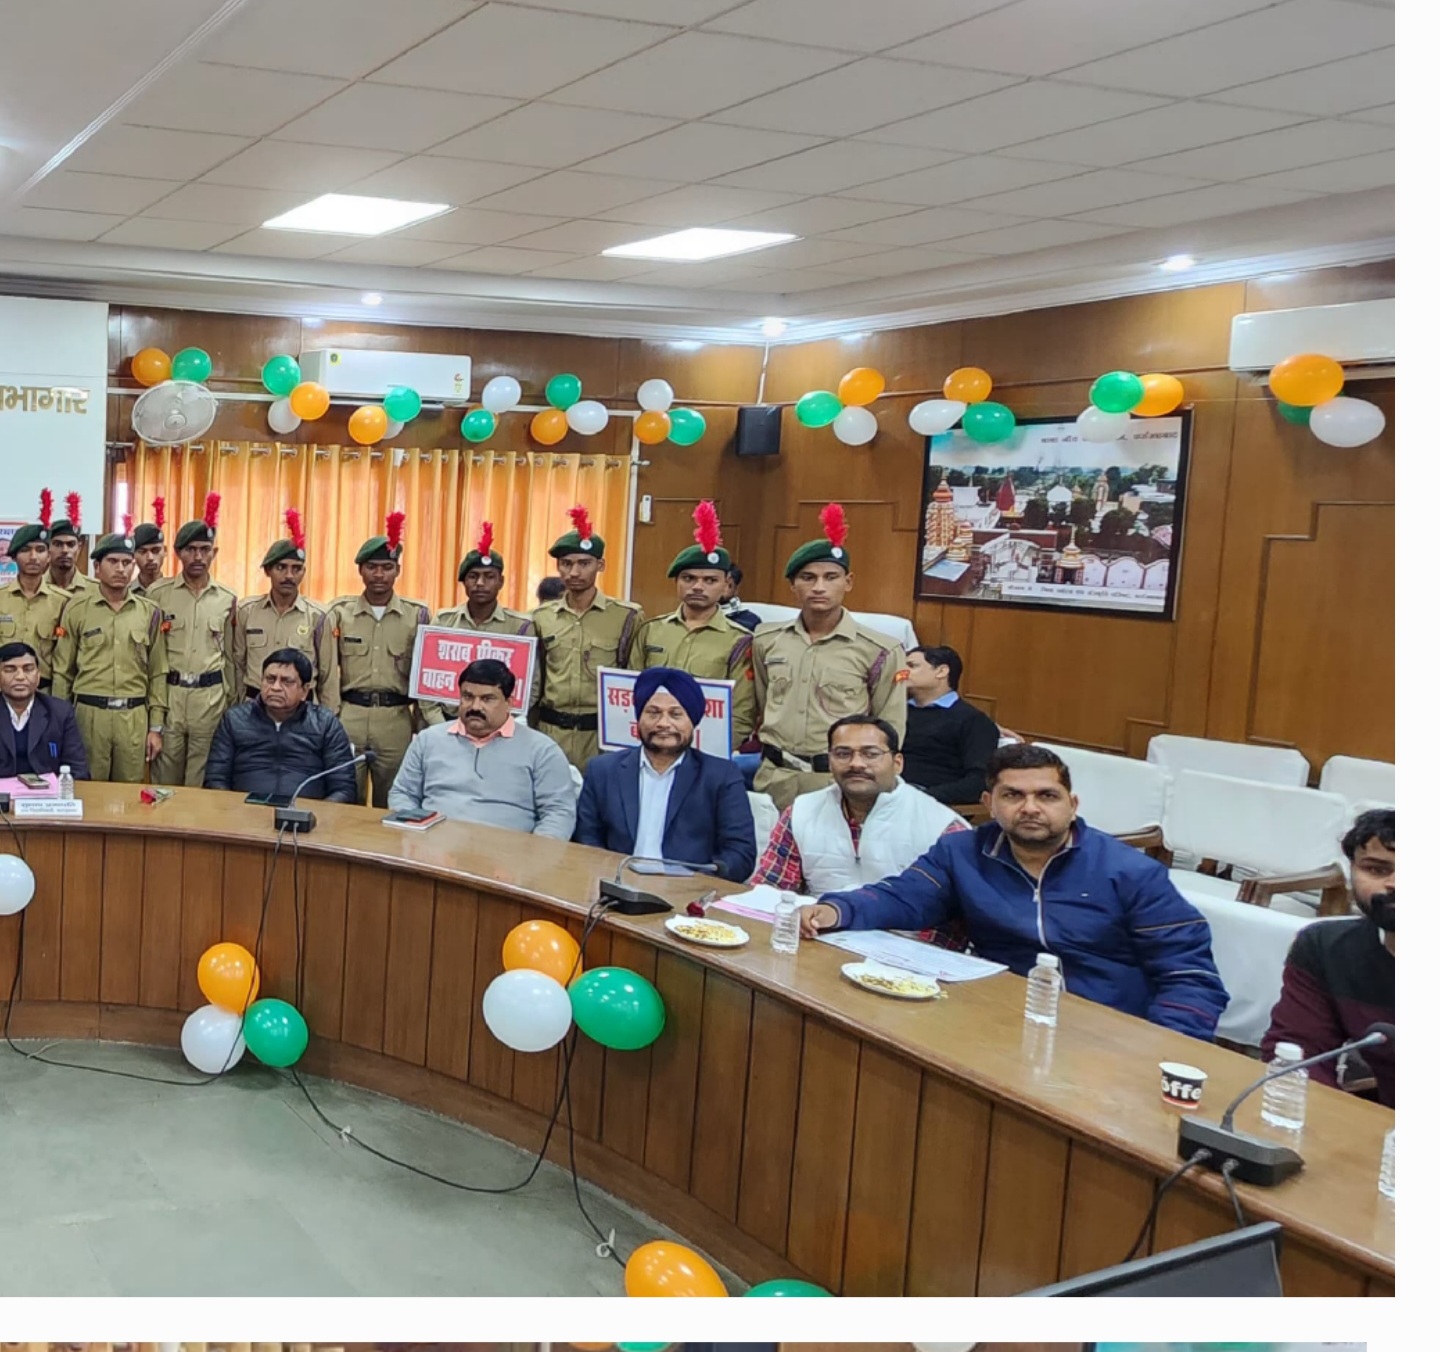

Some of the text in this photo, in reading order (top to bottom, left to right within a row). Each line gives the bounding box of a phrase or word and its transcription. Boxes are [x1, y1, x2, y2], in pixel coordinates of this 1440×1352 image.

[438, 639, 474, 662] शराब
[422, 668, 457, 691] वाहन
[607, 687, 636, 713] सड़
[1161, 1076, 1202, 1100] offe
